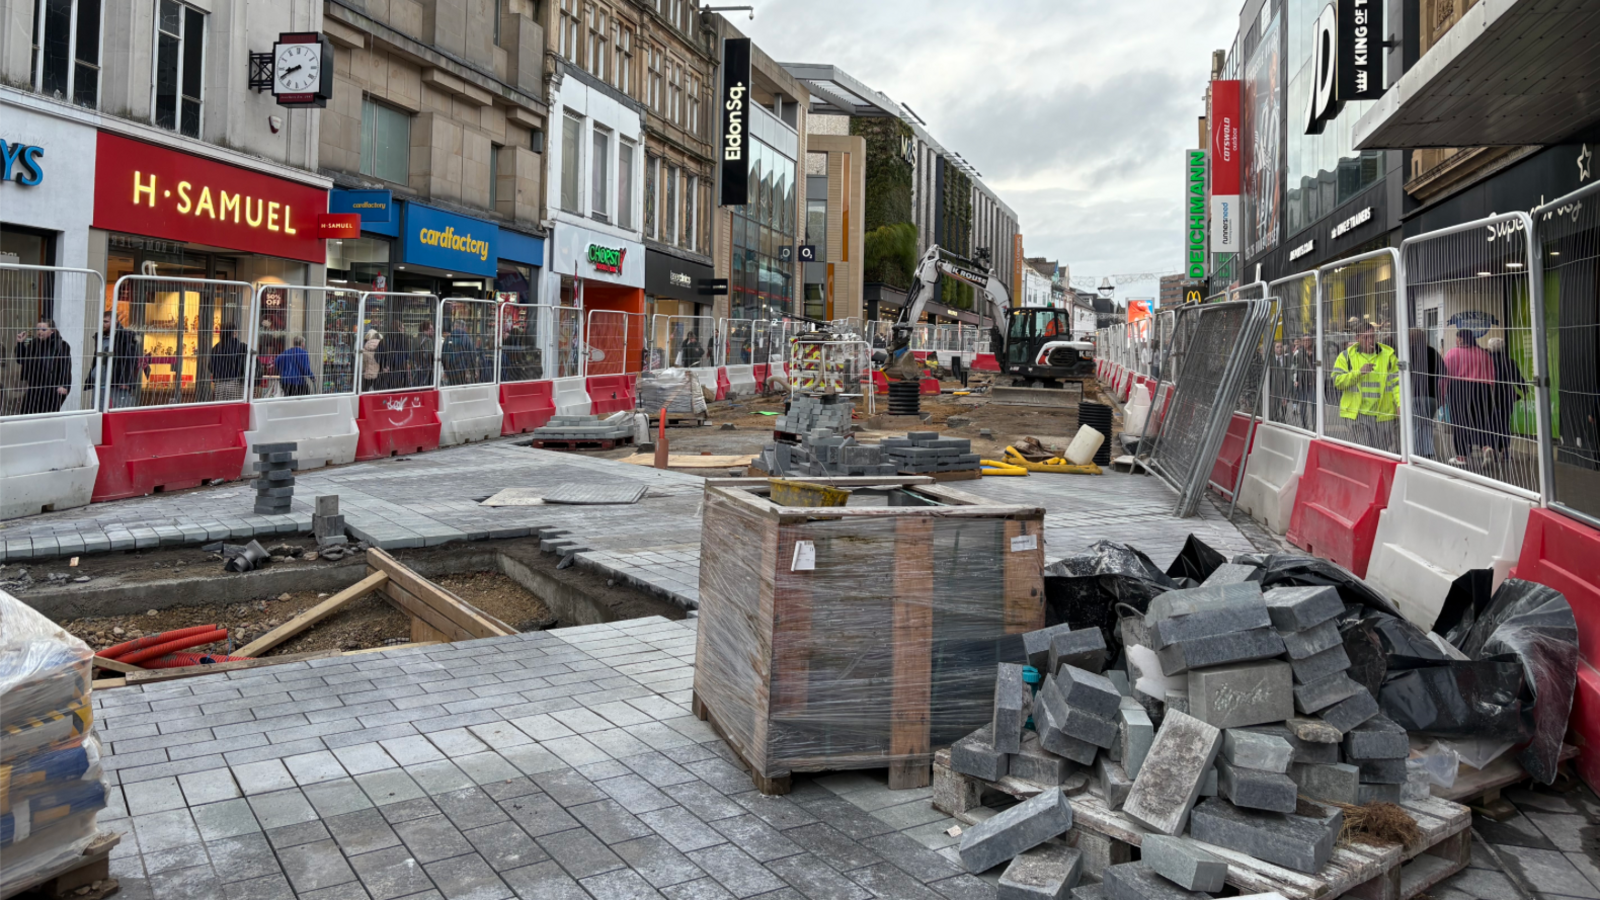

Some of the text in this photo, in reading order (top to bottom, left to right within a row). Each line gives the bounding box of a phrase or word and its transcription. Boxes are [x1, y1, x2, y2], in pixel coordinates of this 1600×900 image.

[1354, 9, 1368, 24] OF
[1354, 26, 1368, 66] KING
[901, 134, 918, 168] M&S
[352, 201, 386, 210] cardfactory
[1189, 151, 1205, 278] DEICHMANN
[1221, 202, 1229, 245] runnersneed
[419, 226, 489, 261] cardfactory
[952, 266, 959, 274] K
